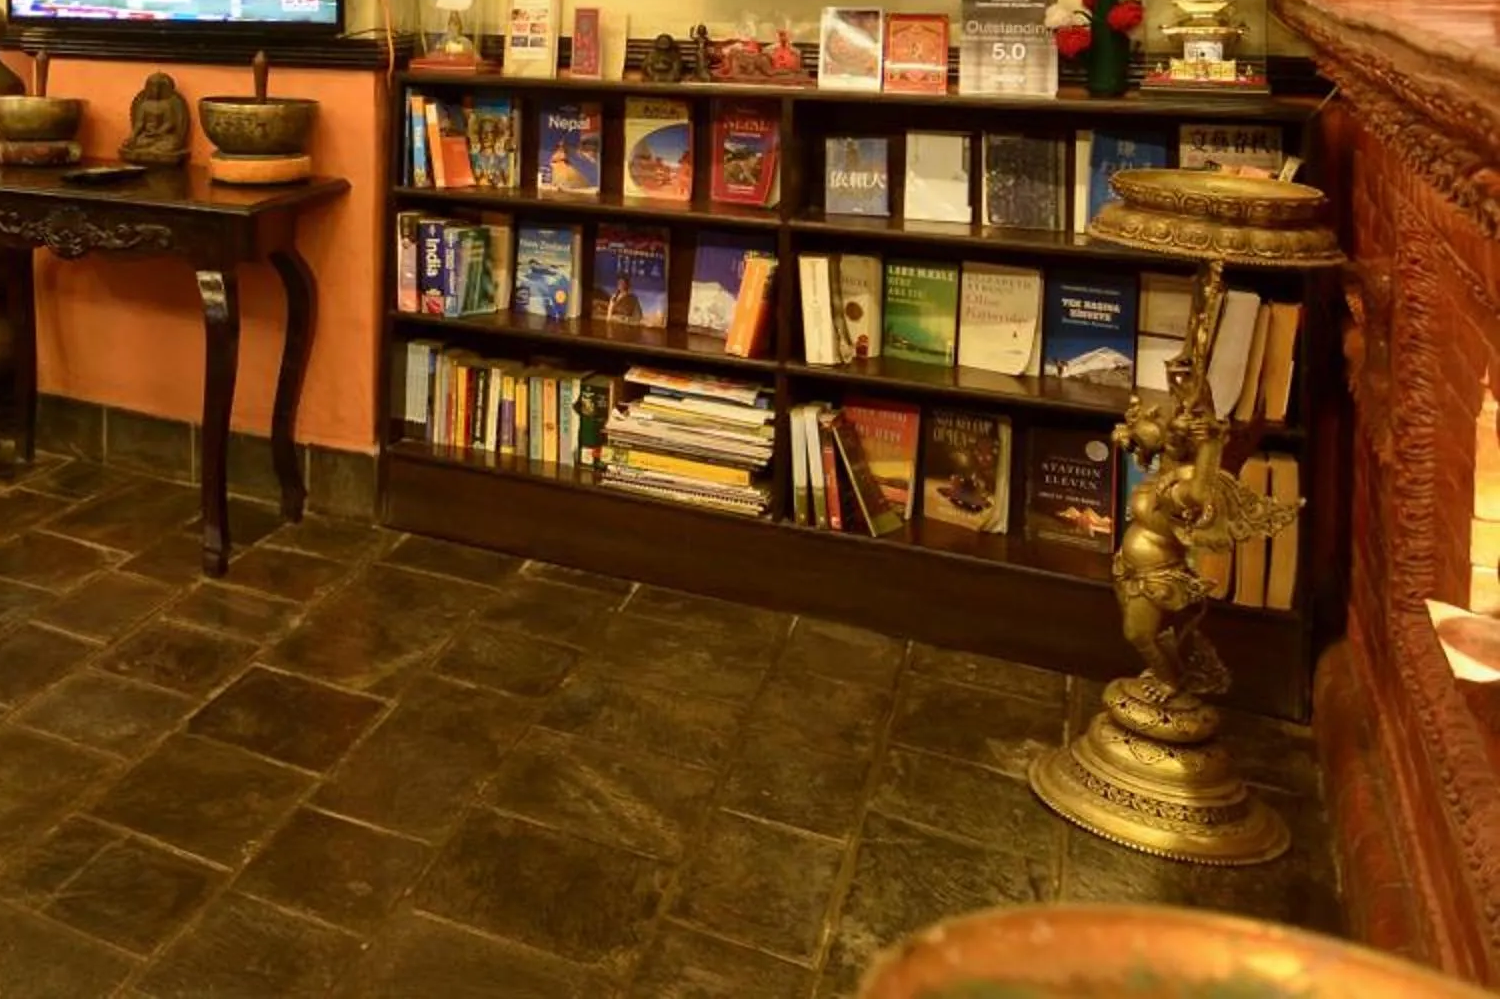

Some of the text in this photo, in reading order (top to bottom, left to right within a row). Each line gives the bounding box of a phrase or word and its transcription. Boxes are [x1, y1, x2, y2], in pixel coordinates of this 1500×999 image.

[991, 42, 1026, 61] 5.0
[548, 112, 591, 132] Nepal
[425, 237, 442, 277] India
[1041, 462, 1101, 479] STATION
[1044, 474, 1097, 490] ELEVEN
